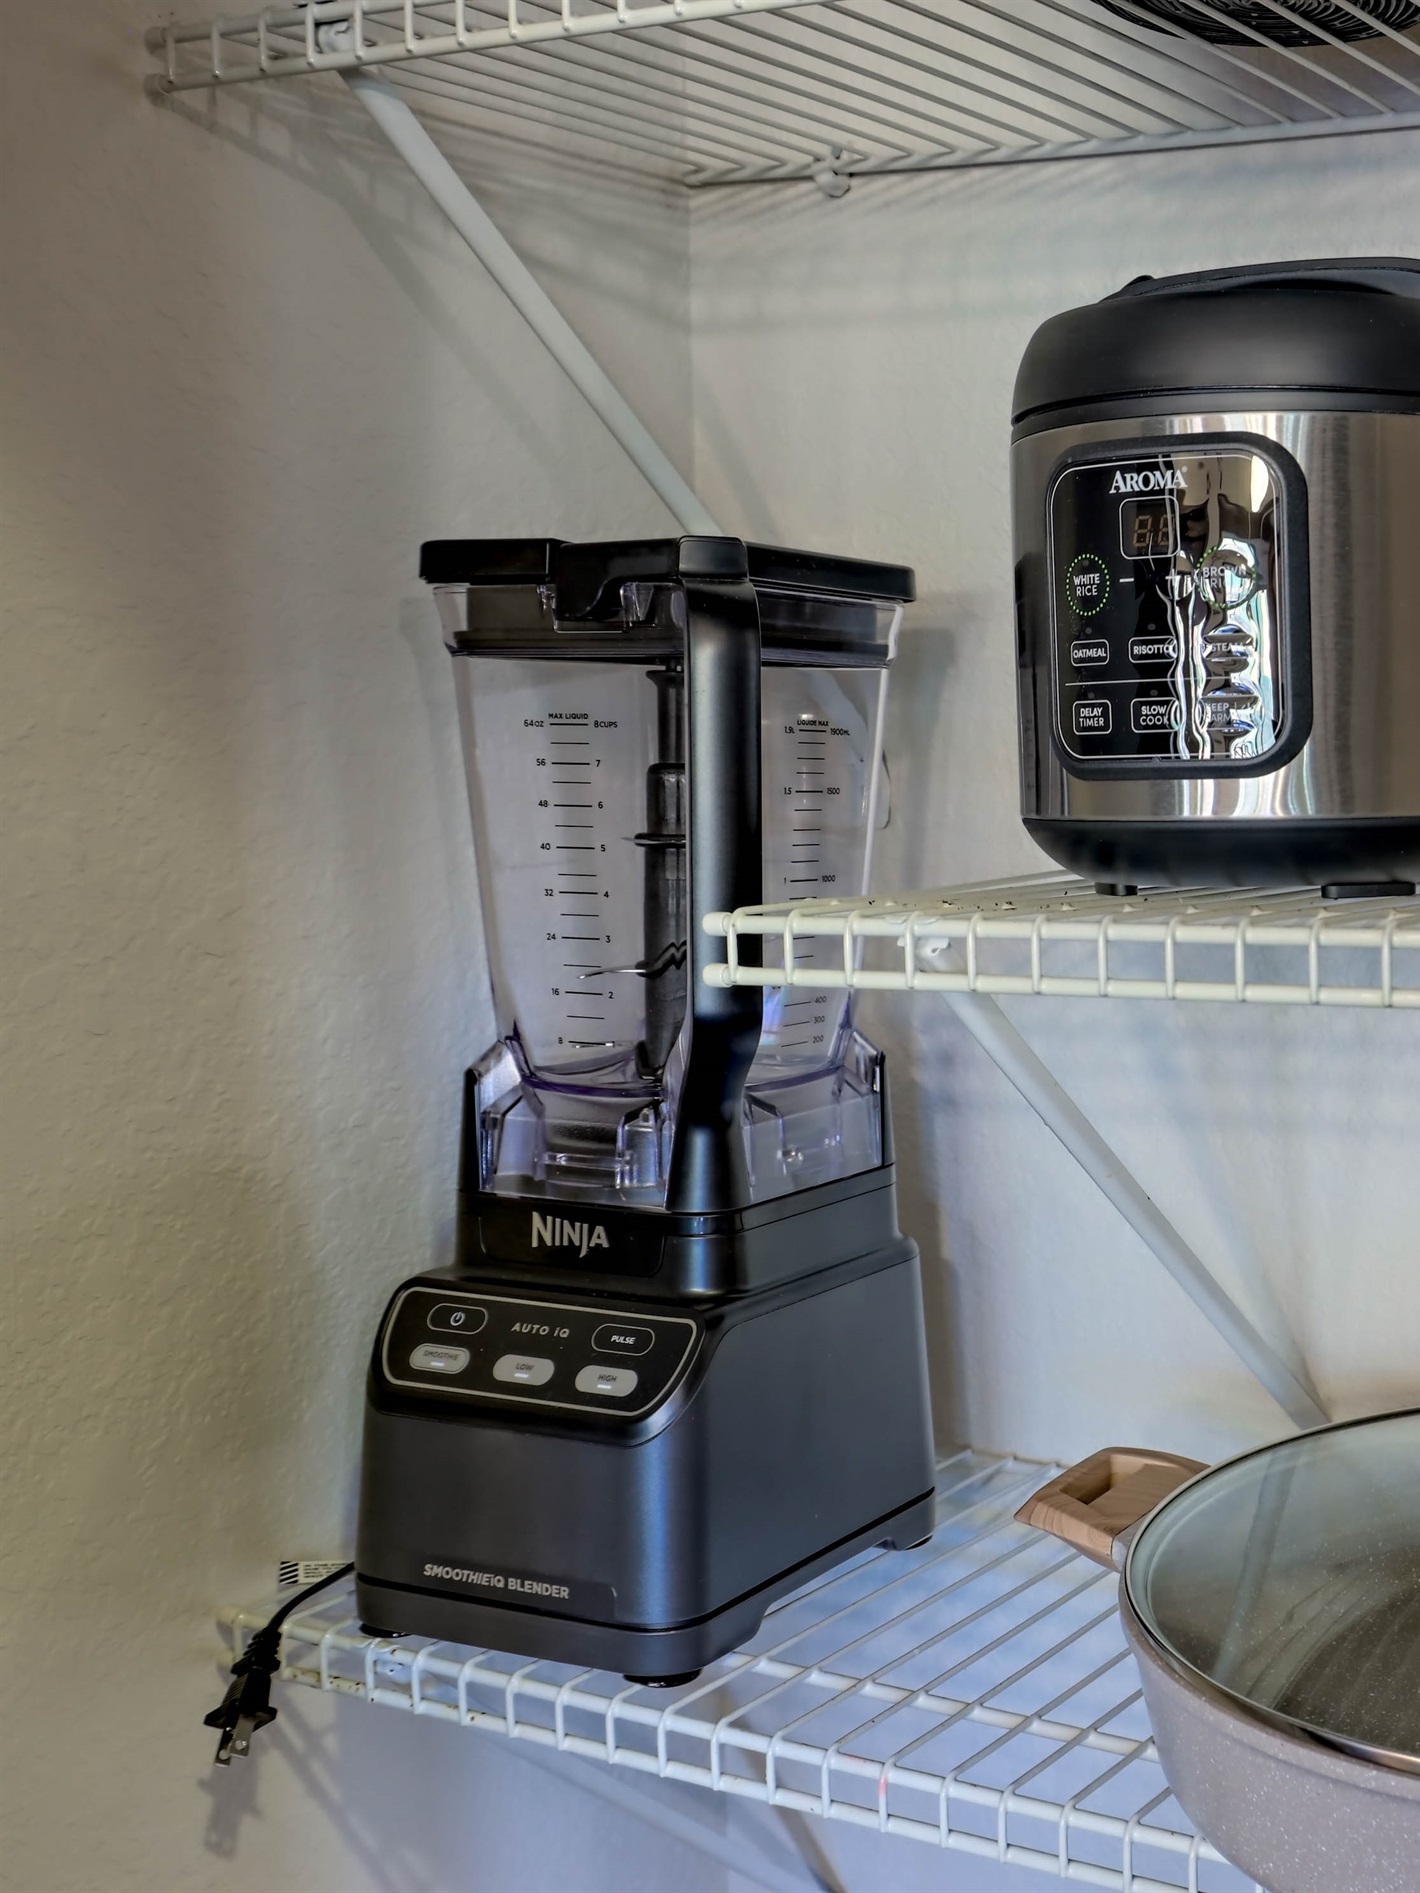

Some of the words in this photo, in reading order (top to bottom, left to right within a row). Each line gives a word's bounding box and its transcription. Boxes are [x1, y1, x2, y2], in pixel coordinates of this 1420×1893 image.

[1109, 467, 1187, 494] AROMA
[1073, 573, 1100, 586] WHITE
[1076, 585, 1098, 597] RICE
[1073, 648, 1107, 658] OATMEAL
[1080, 707, 1103, 717] DELAY
[1141, 705, 1167, 715] SLOW
[1079, 717, 1105, 728] TIMER
[1140, 716, 1169, 725] COOK
[536, 758, 546, 767] 56
[595, 759, 601, 768] 7
[538, 800, 549, 808] 48
[597, 801, 604, 809] 6
[540, 842, 551, 851] 40
[600, 844, 606, 852] 5
[821, 875, 836, 883] 1000
[544, 889, 554, 897] 32
[603, 891, 610, 899] 4
[546, 933, 556, 941] 24
[605, 935, 611, 943] 3
[551, 988, 560, 996] 16
[608, 991, 614, 999] 2
[814, 996, 827, 1004] 400
[813, 1015, 825, 1024] 300
[557, 1037, 563, 1045] 8
[812, 1035, 824, 1043] 200
[531, 1211, 610, 1258] NINJA
[511, 1322, 550, 1336] AUTO
[610, 1335, 636, 1345] PULSE
[422, 1349, 461, 1361] SMOOTHIE
[515, 1362, 535, 1372] LOW
[597, 1373, 617, 1383] HIGH
[507, 1577, 570, 1599] BLENDER
